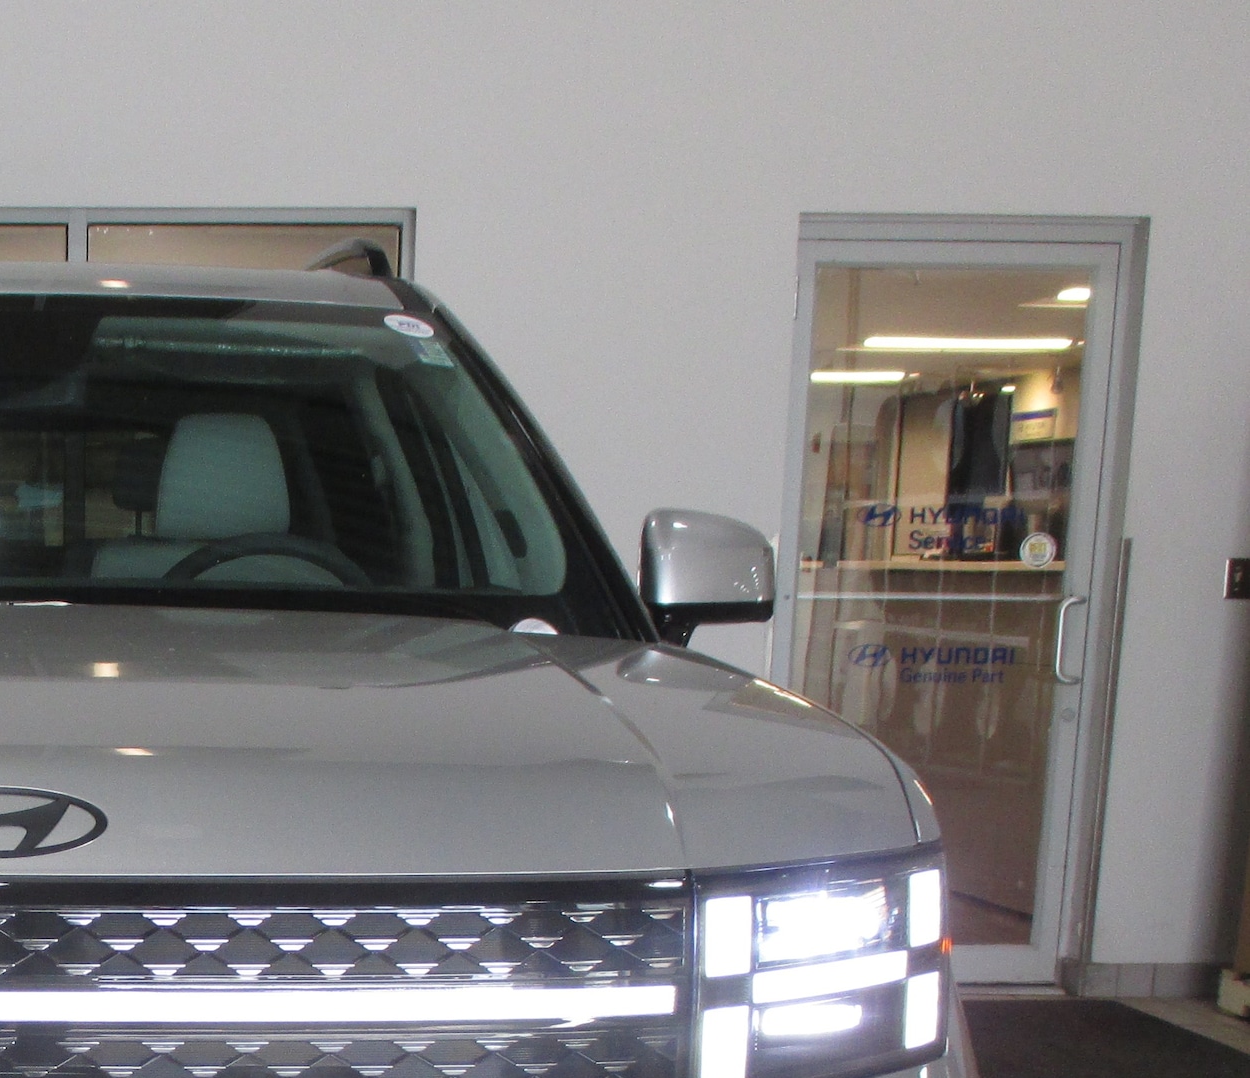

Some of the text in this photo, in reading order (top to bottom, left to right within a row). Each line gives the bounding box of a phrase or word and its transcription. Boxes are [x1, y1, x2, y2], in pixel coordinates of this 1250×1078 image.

[900, 646, 1016, 665] HYUNDAI
[899, 667, 1005, 685] Genuine Part
